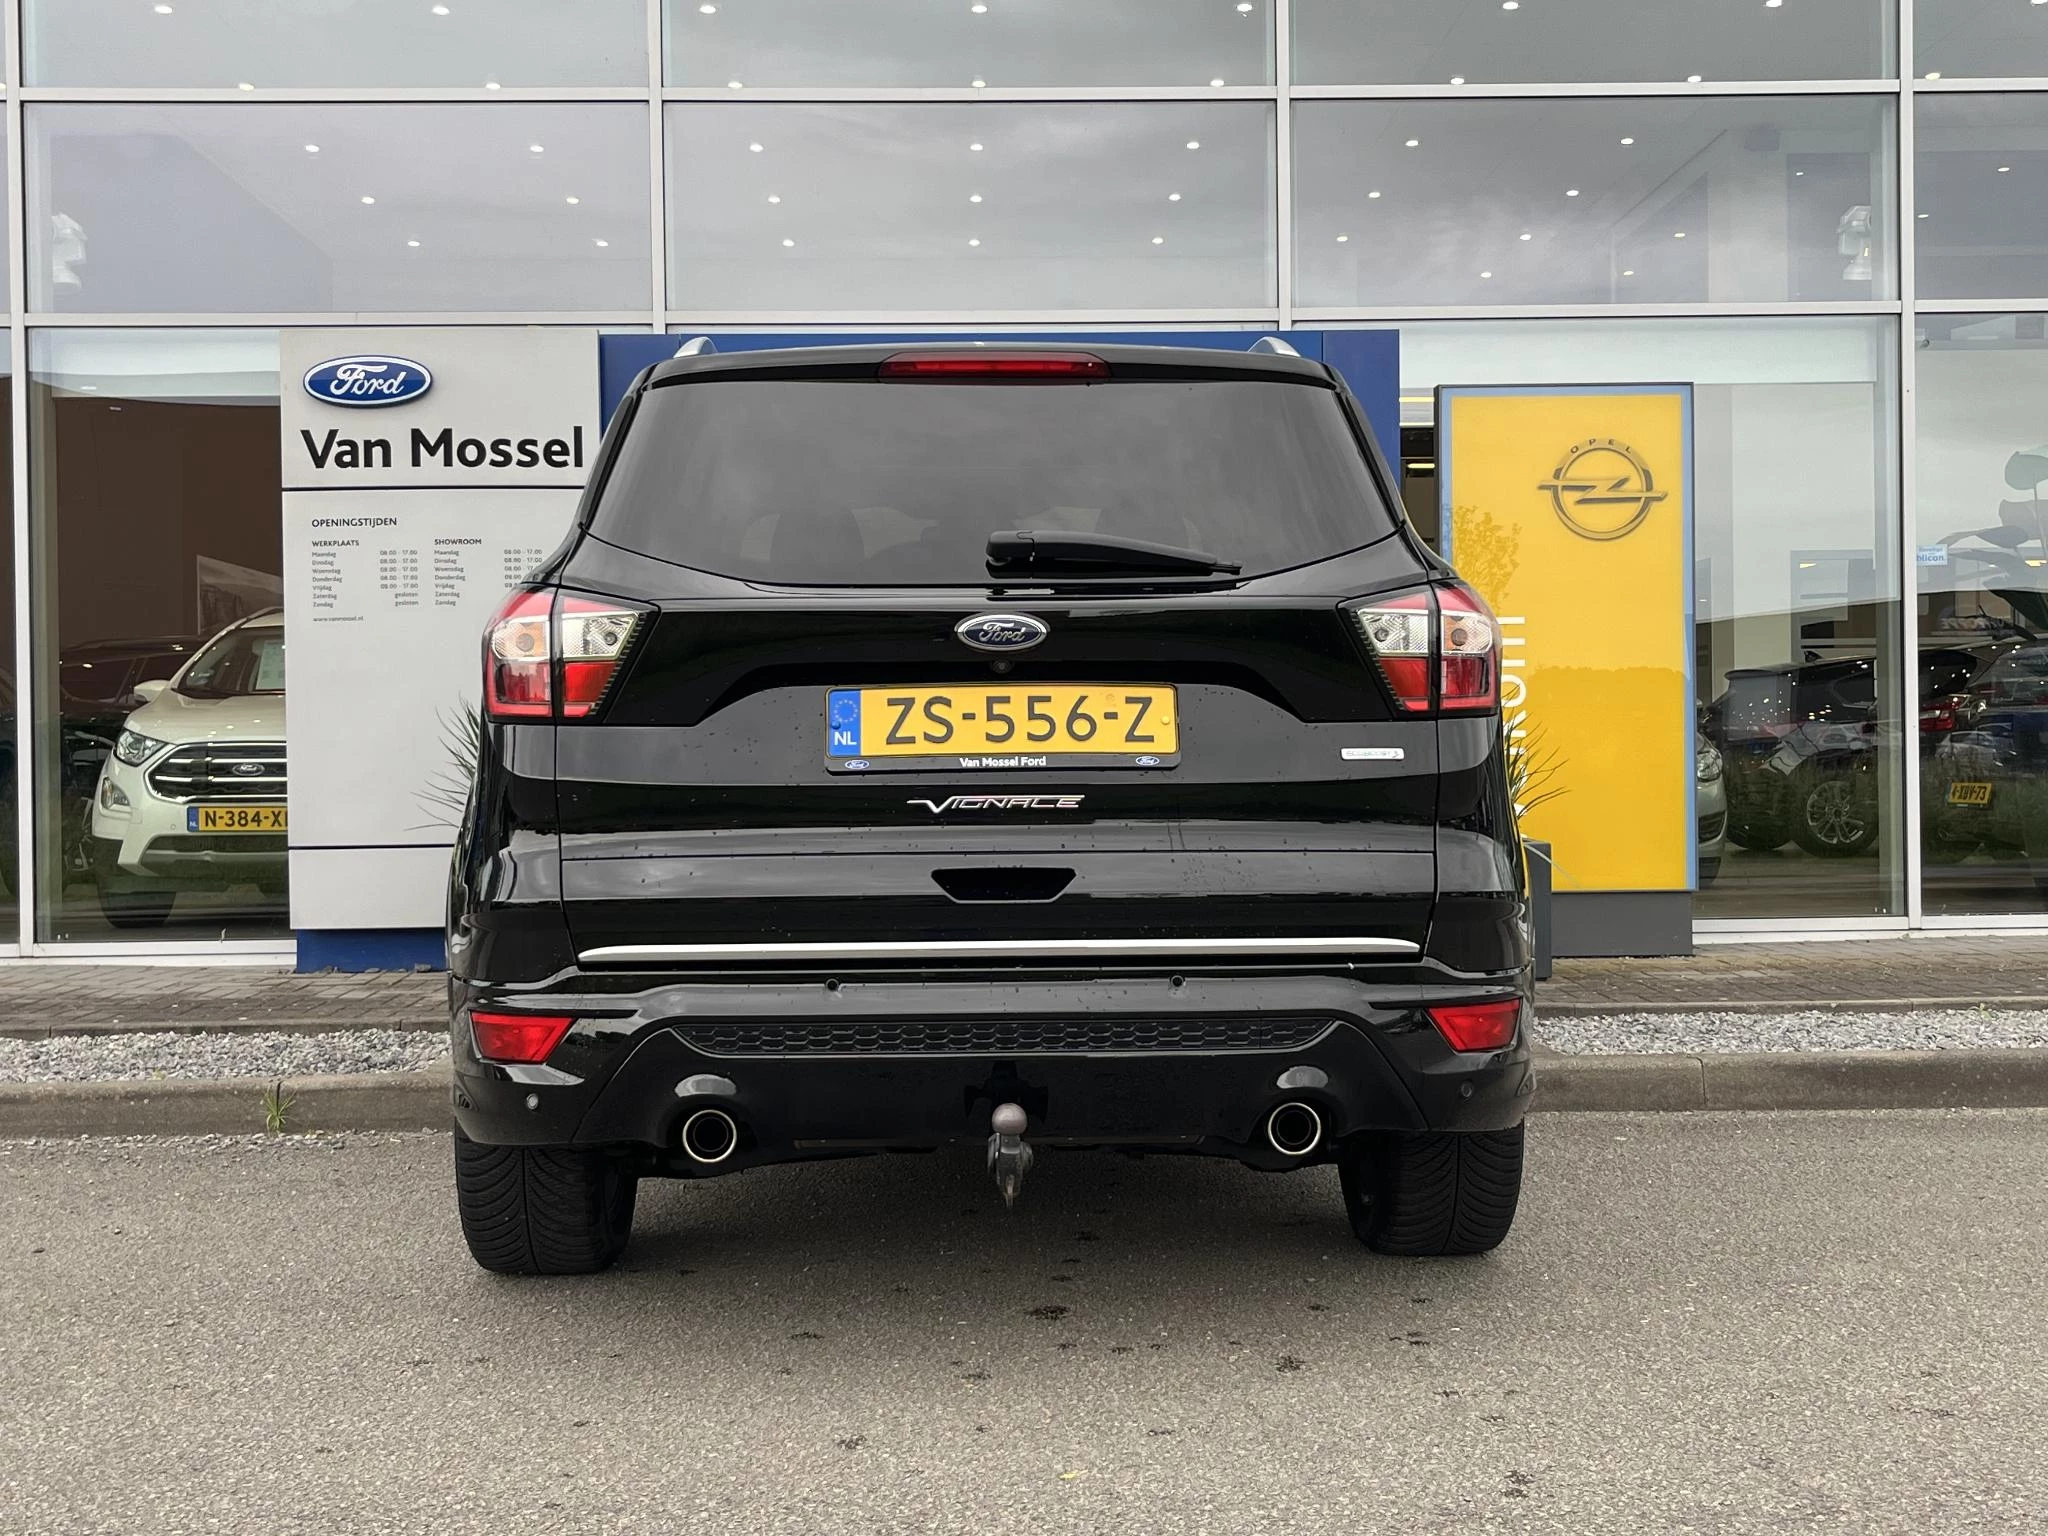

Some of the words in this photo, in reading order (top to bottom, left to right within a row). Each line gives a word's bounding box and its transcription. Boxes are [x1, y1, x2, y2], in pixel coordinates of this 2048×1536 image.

[330, 364, 406, 395] Ford
[300, 428, 392, 469] Van
[411, 426, 583, 468] Mossel
[1570, 438, 1631, 454] OPEL
[312, 517, 398, 528] OPENINGSTIJDEN
[979, 622, 1026, 641] Ford
[834, 731, 857, 745] NL
[886, 695, 1155, 744] ZS-556-Z
[959, 757, 980, 767] Van
[982, 756, 1019, 767] Mossel
[1020, 756, 1046, 766] Ford
[907, 794, 1086, 814] VIGNALE
[204, 810, 288, 828] N-384-X
